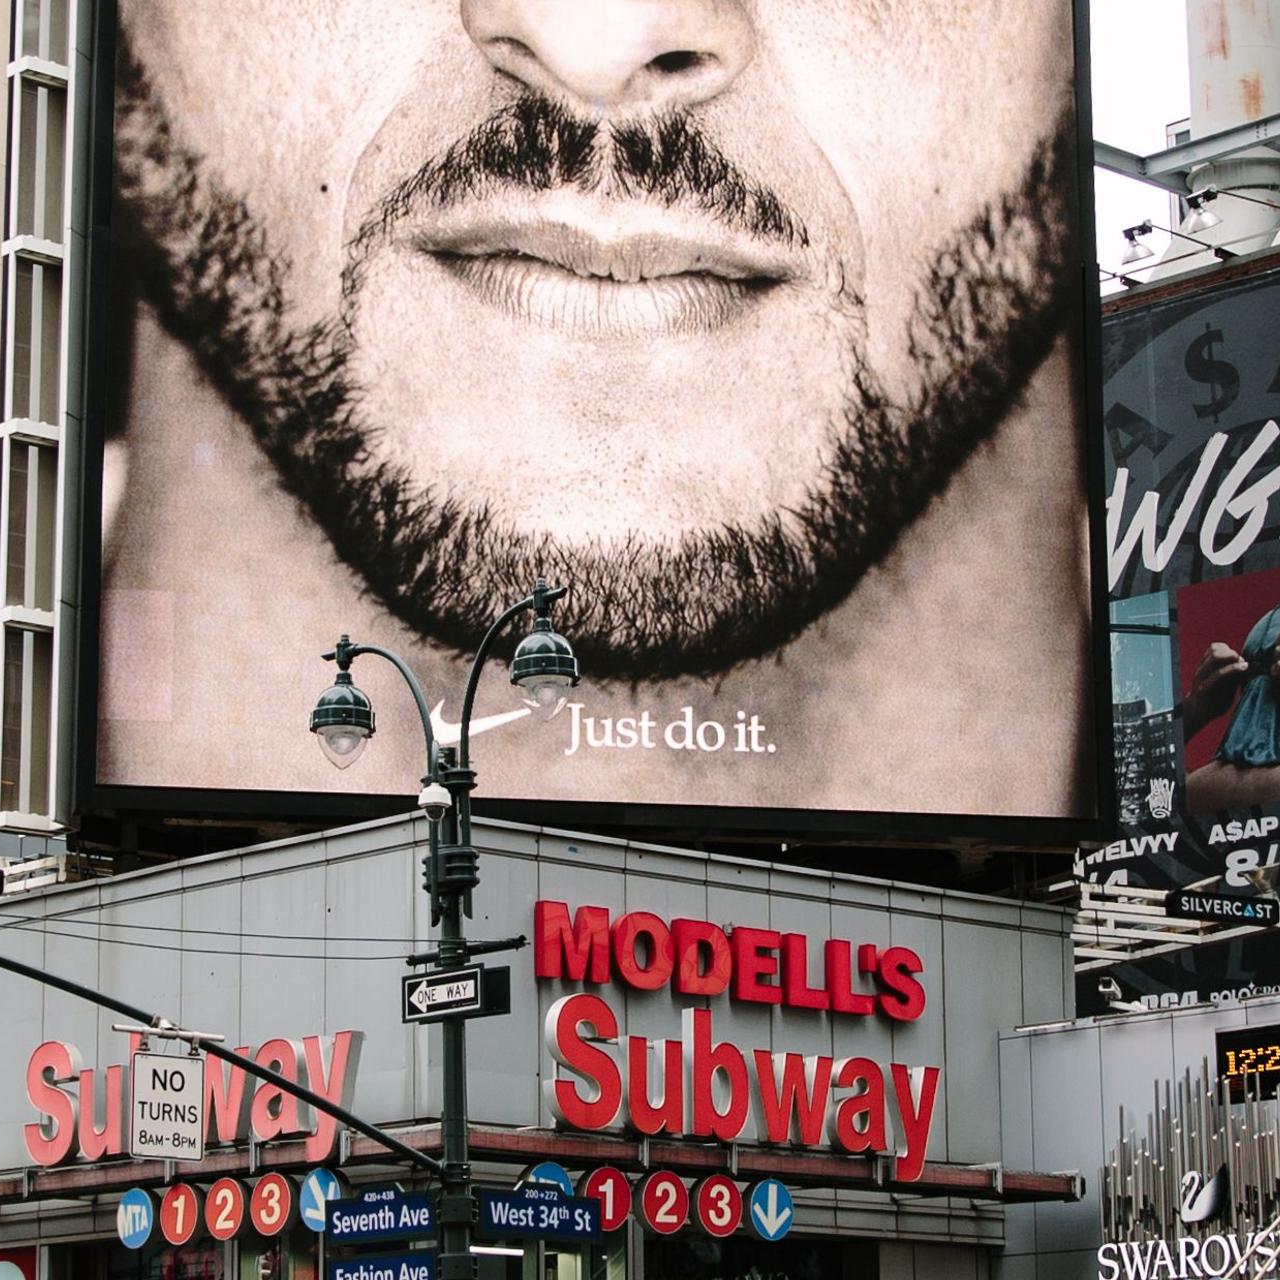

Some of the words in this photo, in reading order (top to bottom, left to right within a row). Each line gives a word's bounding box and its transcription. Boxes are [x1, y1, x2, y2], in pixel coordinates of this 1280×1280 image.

[565, 702, 656, 755] Just
[664, 706, 725, 753] do
[734, 710, 777, 754] it.
[1208, 816, 1279, 845] A$AP
[1181, 896, 1273, 919] SILVERCAST
[534, 900, 926, 1021] MODELL'S
[417, 988, 437, 1004] ONE
[446, 983, 469, 999] WAY
[152, 1068, 185, 1093] NO
[546, 993, 941, 1182] Subway
[25, 1030, 365, 1167] Suway
[138, 1101, 198, 1124] TURNS
[118, 1203, 149, 1234] MTA
[172, 1199, 186, 1234] 1
[216, 1190, 233, 1229] 2
[260, 1183, 281, 1224] 3
[525, 1188, 538, 1199] 200
[545, 1190, 558, 1201] 272
[598, 1180, 615, 1220] 1
[655, 1182, 678, 1223] 2
[708, 1184, 732, 1226] 3
[332, 1206, 395, 1234] Seventh
[399, 1204, 430, 1228] Ave
[490, 1201, 534, 1228] West
[539, 1205, 570, 1229] 34th
[574, 1208, 591, 1232] St
